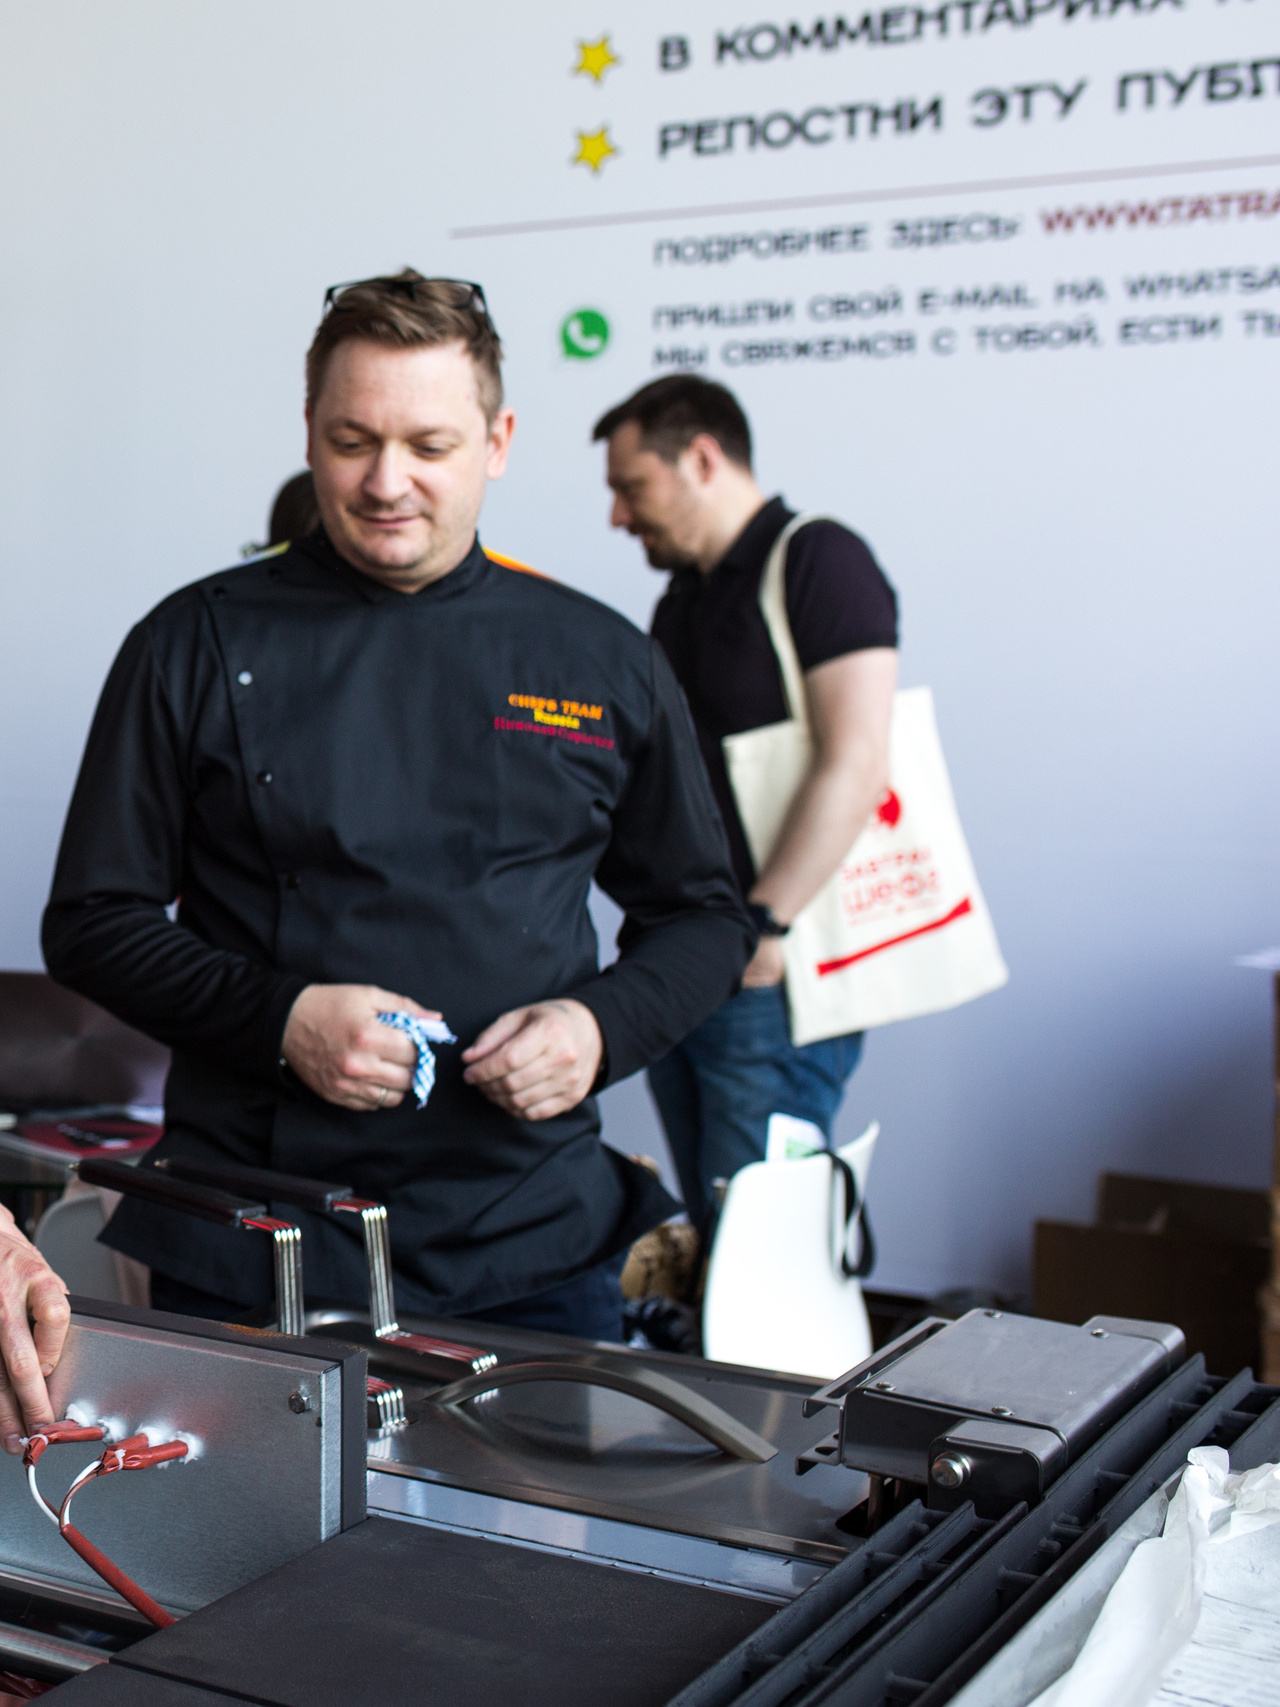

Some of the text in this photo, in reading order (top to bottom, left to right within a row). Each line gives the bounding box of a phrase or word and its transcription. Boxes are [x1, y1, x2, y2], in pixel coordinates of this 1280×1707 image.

[659, 0, 1184, 71] В КОММЕНТАРИ
[659, 94, 942, 157] РЕПОСТНИ
[971, 76, 1087, 126] ЭТУ
[653, 222, 869, 266] ПОДРОБНЕЕ
[652, 299, 794, 329] ПРИШЛИ
[808, 285, 903, 322] СВОЙ
[1054, 277, 1105, 303] НА
[652, 343, 708, 367] МЫ
[722, 331, 916, 366] СВЯЖЕМСЯ
[931, 328, 958, 356] С
[1119, 314, 1221, 345] ЕСЛИ
